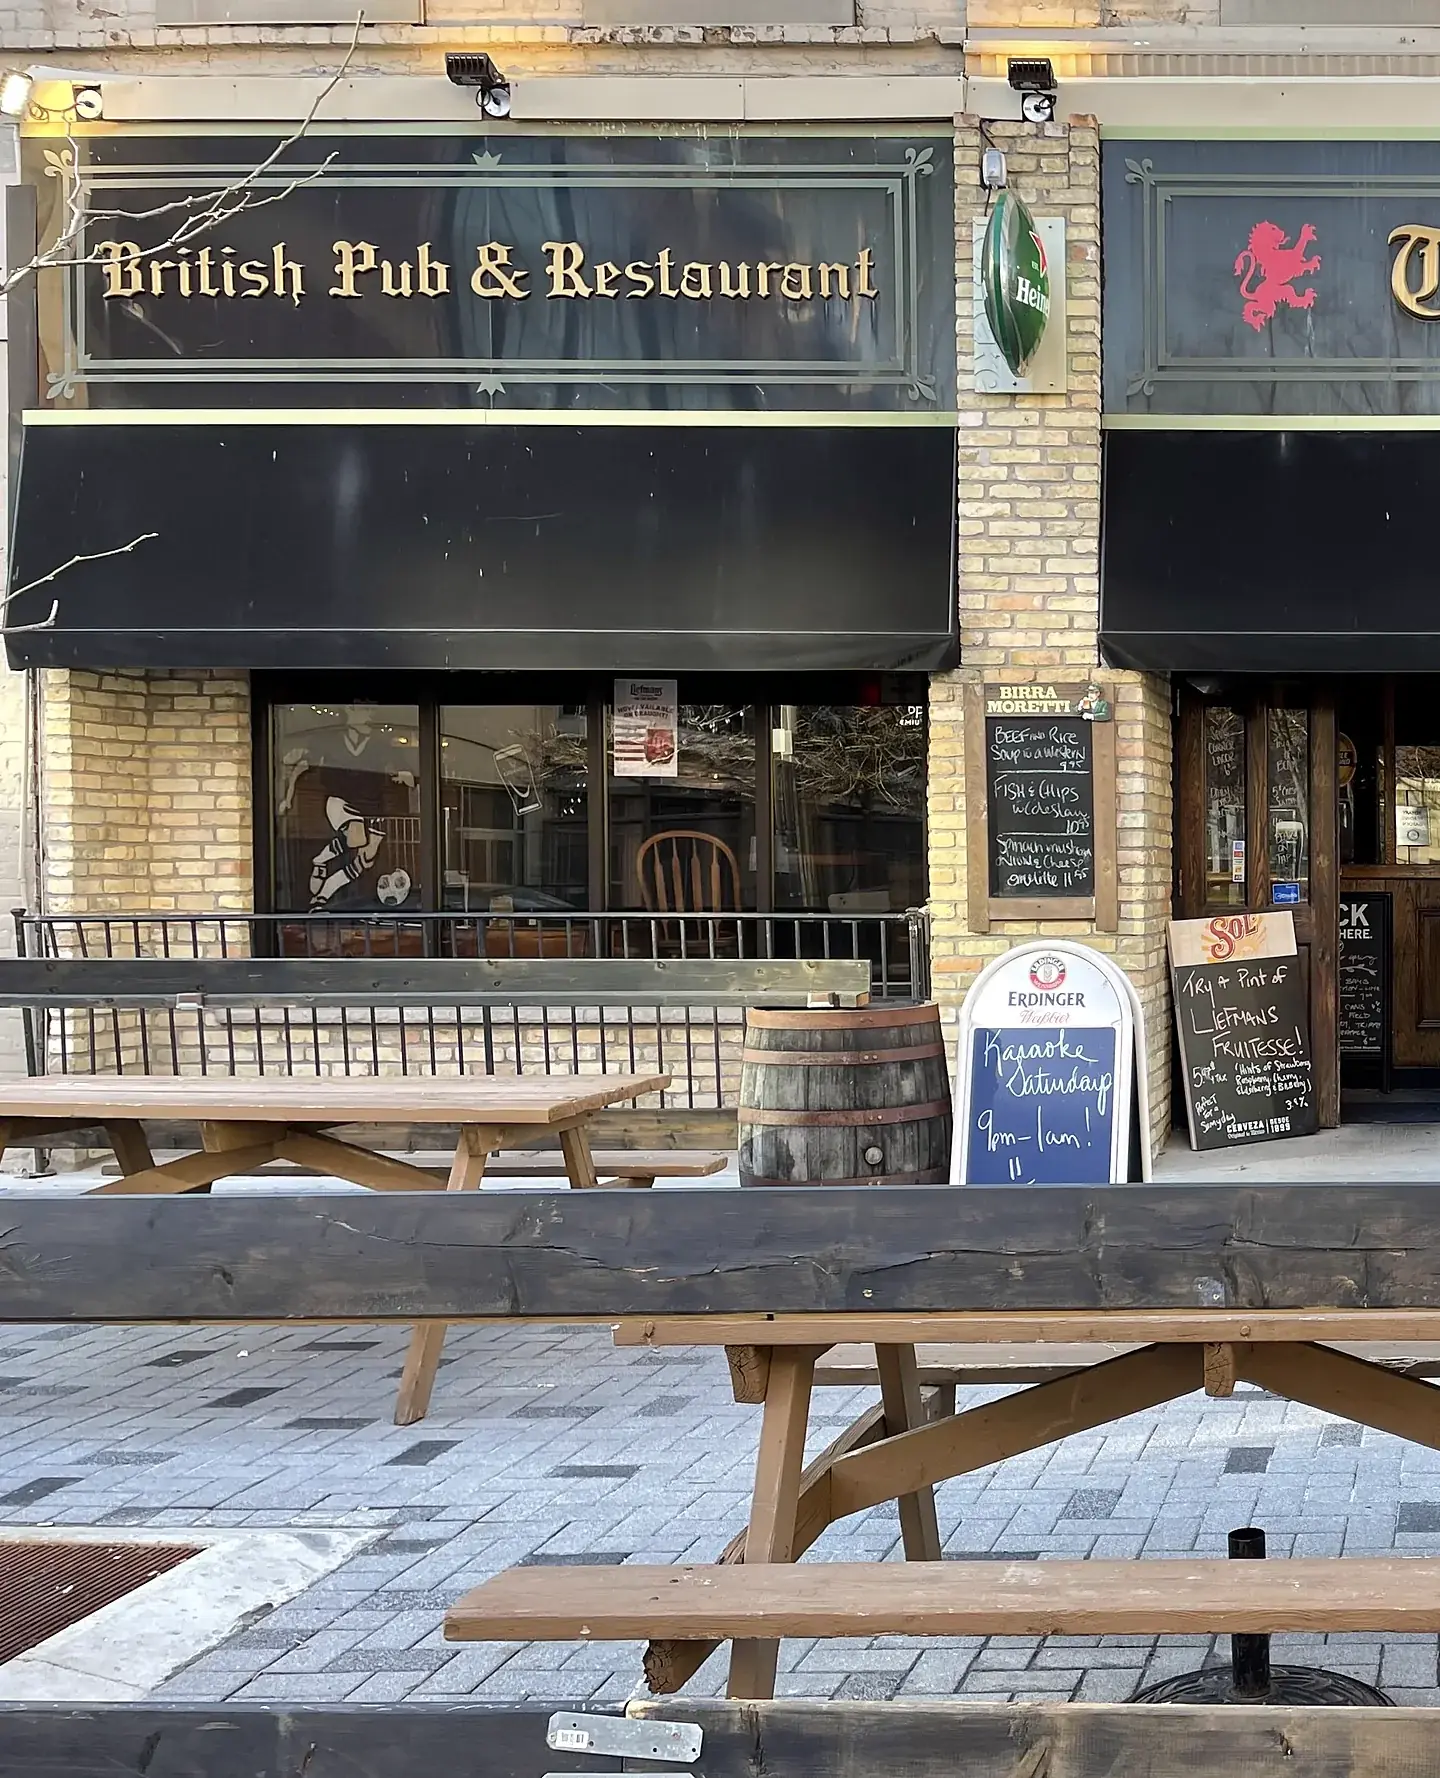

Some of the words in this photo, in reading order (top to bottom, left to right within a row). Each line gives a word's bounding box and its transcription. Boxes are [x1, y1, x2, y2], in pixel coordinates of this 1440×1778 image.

[101, 241, 305, 308] British
[329, 241, 450, 300] Pub
[470, 241, 533, 300] &
[542, 241, 881, 301] Restaurant
[999, 686, 1057, 700] BIRRA
[986, 701, 1071, 714] MORETTI
[995, 726, 1031, 744] BEEF
[1236, 967, 1268, 989] Pint
[1008, 991, 1086, 1008] ERDINGER
[1190, 1005, 1279, 1035] LIEFMANS
[1211, 1025, 1304, 1059] FRUITESSE!
[984, 1028, 1100, 1077] Karaoke
[1226, 1120, 1265, 1134] CERVEZA
[1270, 1123, 1291, 1134] 1899
